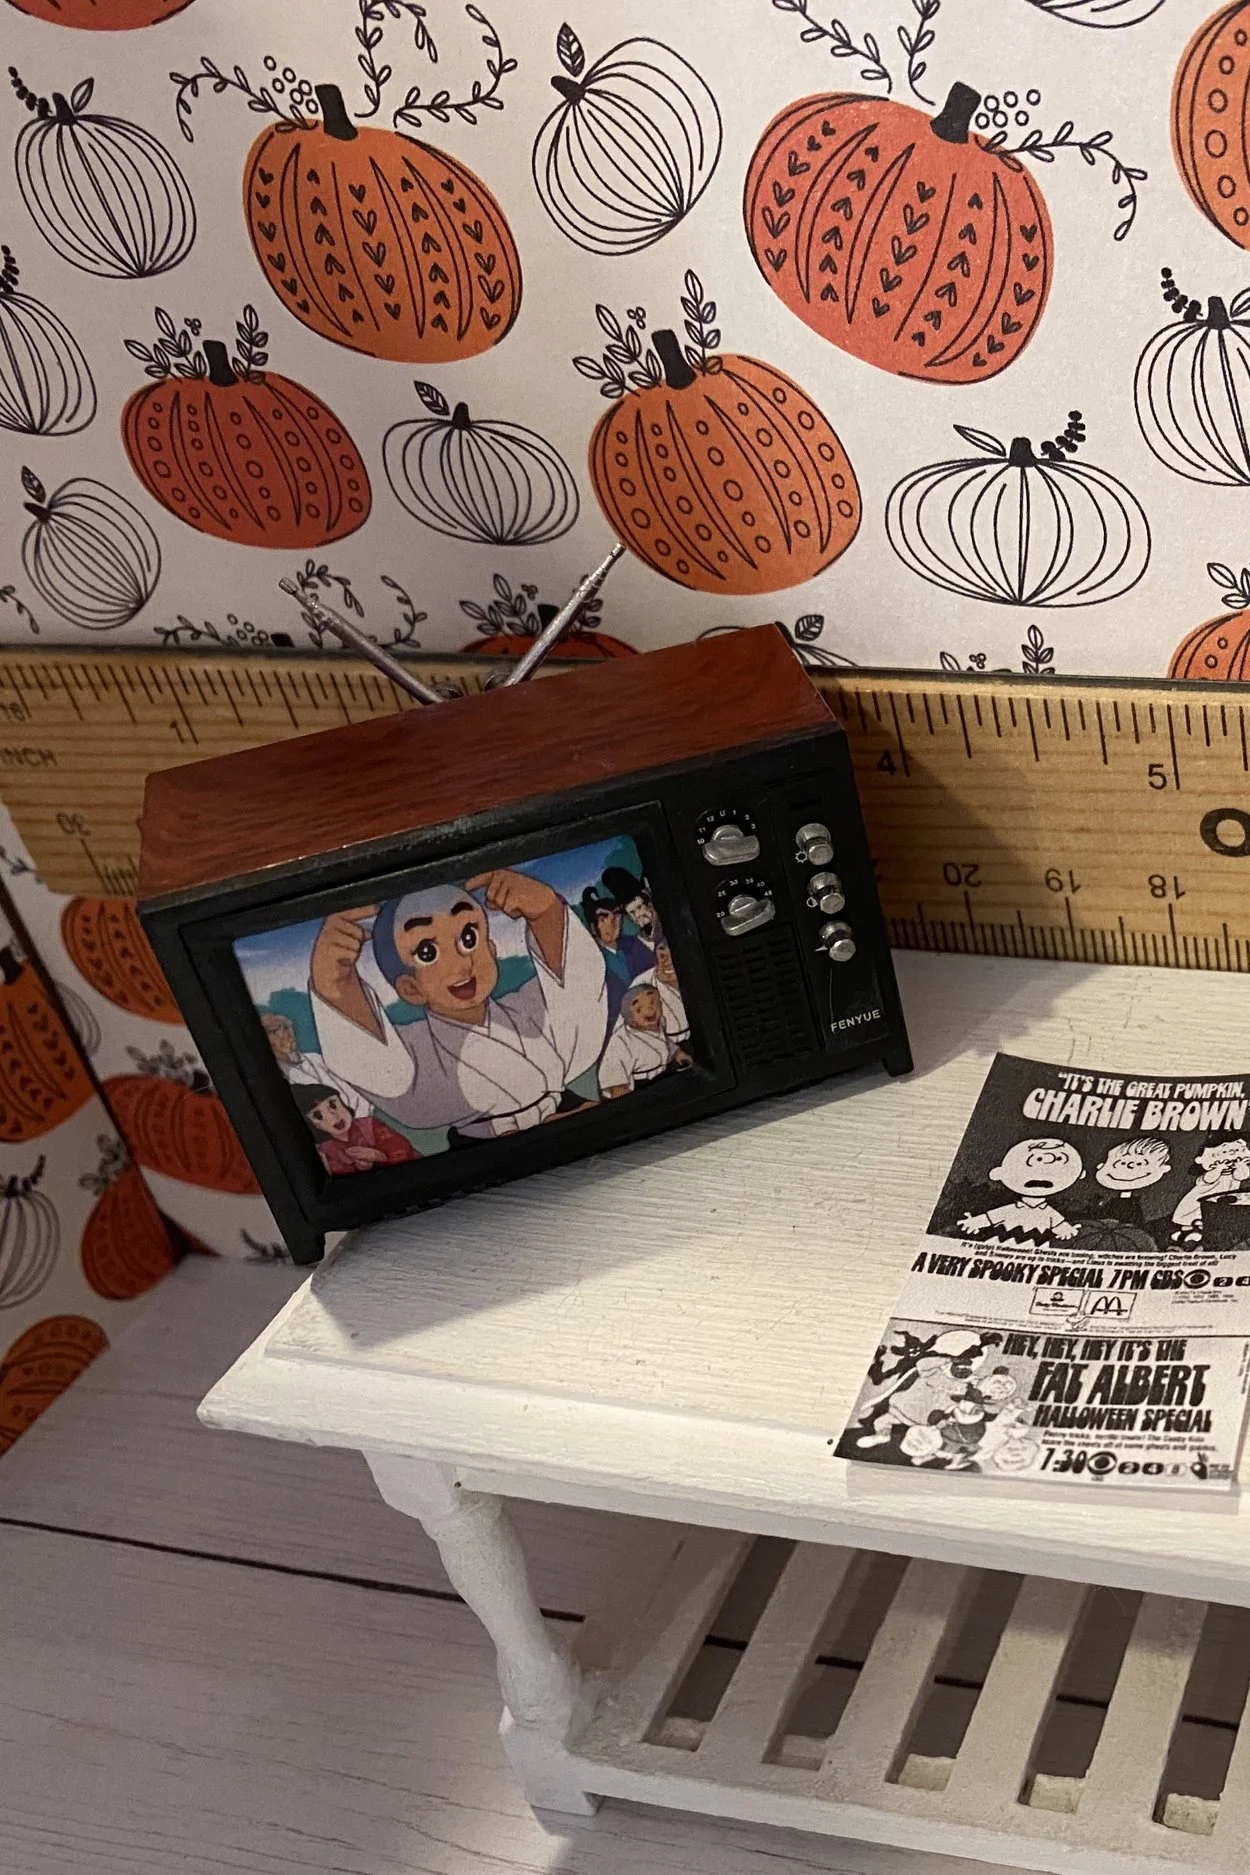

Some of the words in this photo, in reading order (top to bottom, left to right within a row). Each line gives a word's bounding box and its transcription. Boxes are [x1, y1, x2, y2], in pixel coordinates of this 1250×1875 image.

[170, 720, 185, 744] 1
[877, 750, 896, 775] 4
[1149, 764, 1168, 790] 5
[706, 815, 716, 823] 12
[729, 879, 739, 887] 30
[943, 861, 982, 888] 20
[1044, 868, 1082, 893] 19
[1148, 874, 1186, 901] 18
[830, 1009, 881, 1032] FENYUE
[1096, 1077, 1125, 1096] THE
[1126, 1081, 1172, 1098] GREAT
[1174, 1081, 1245, 1100] PUMPKIN,
[1022, 1088, 1140, 1129] CHARLIE
[911, 1252, 927, 1272] A
[927, 1253, 972, 1277] VERY
[967, 1258, 1040, 1284] SPOOKY
[1036, 1264, 1104, 1288] SPECIAL
[1106, 1269, 1150, 1290] 7PM
[1150, 1269, 1185, 1290] CBS
[1002, 1333, 1041, 1359] HEY,
[1041, 1337, 1079, 1362] HEY,
[1080, 1338, 1118, 1361] HEY
[1117, 1339, 1152, 1362] IT'S
[1154, 1339, 1188, 1362] THE
[1027, 1360, 1090, 1404] FAT
[1085, 1364, 1211, 1407] ALBERT
[1032, 1404, 1139, 1431] HALLOWEEN
[1140, 1408, 1213, 1432] SPECIAL
[1040, 1448, 1088, 1474] 7:30
